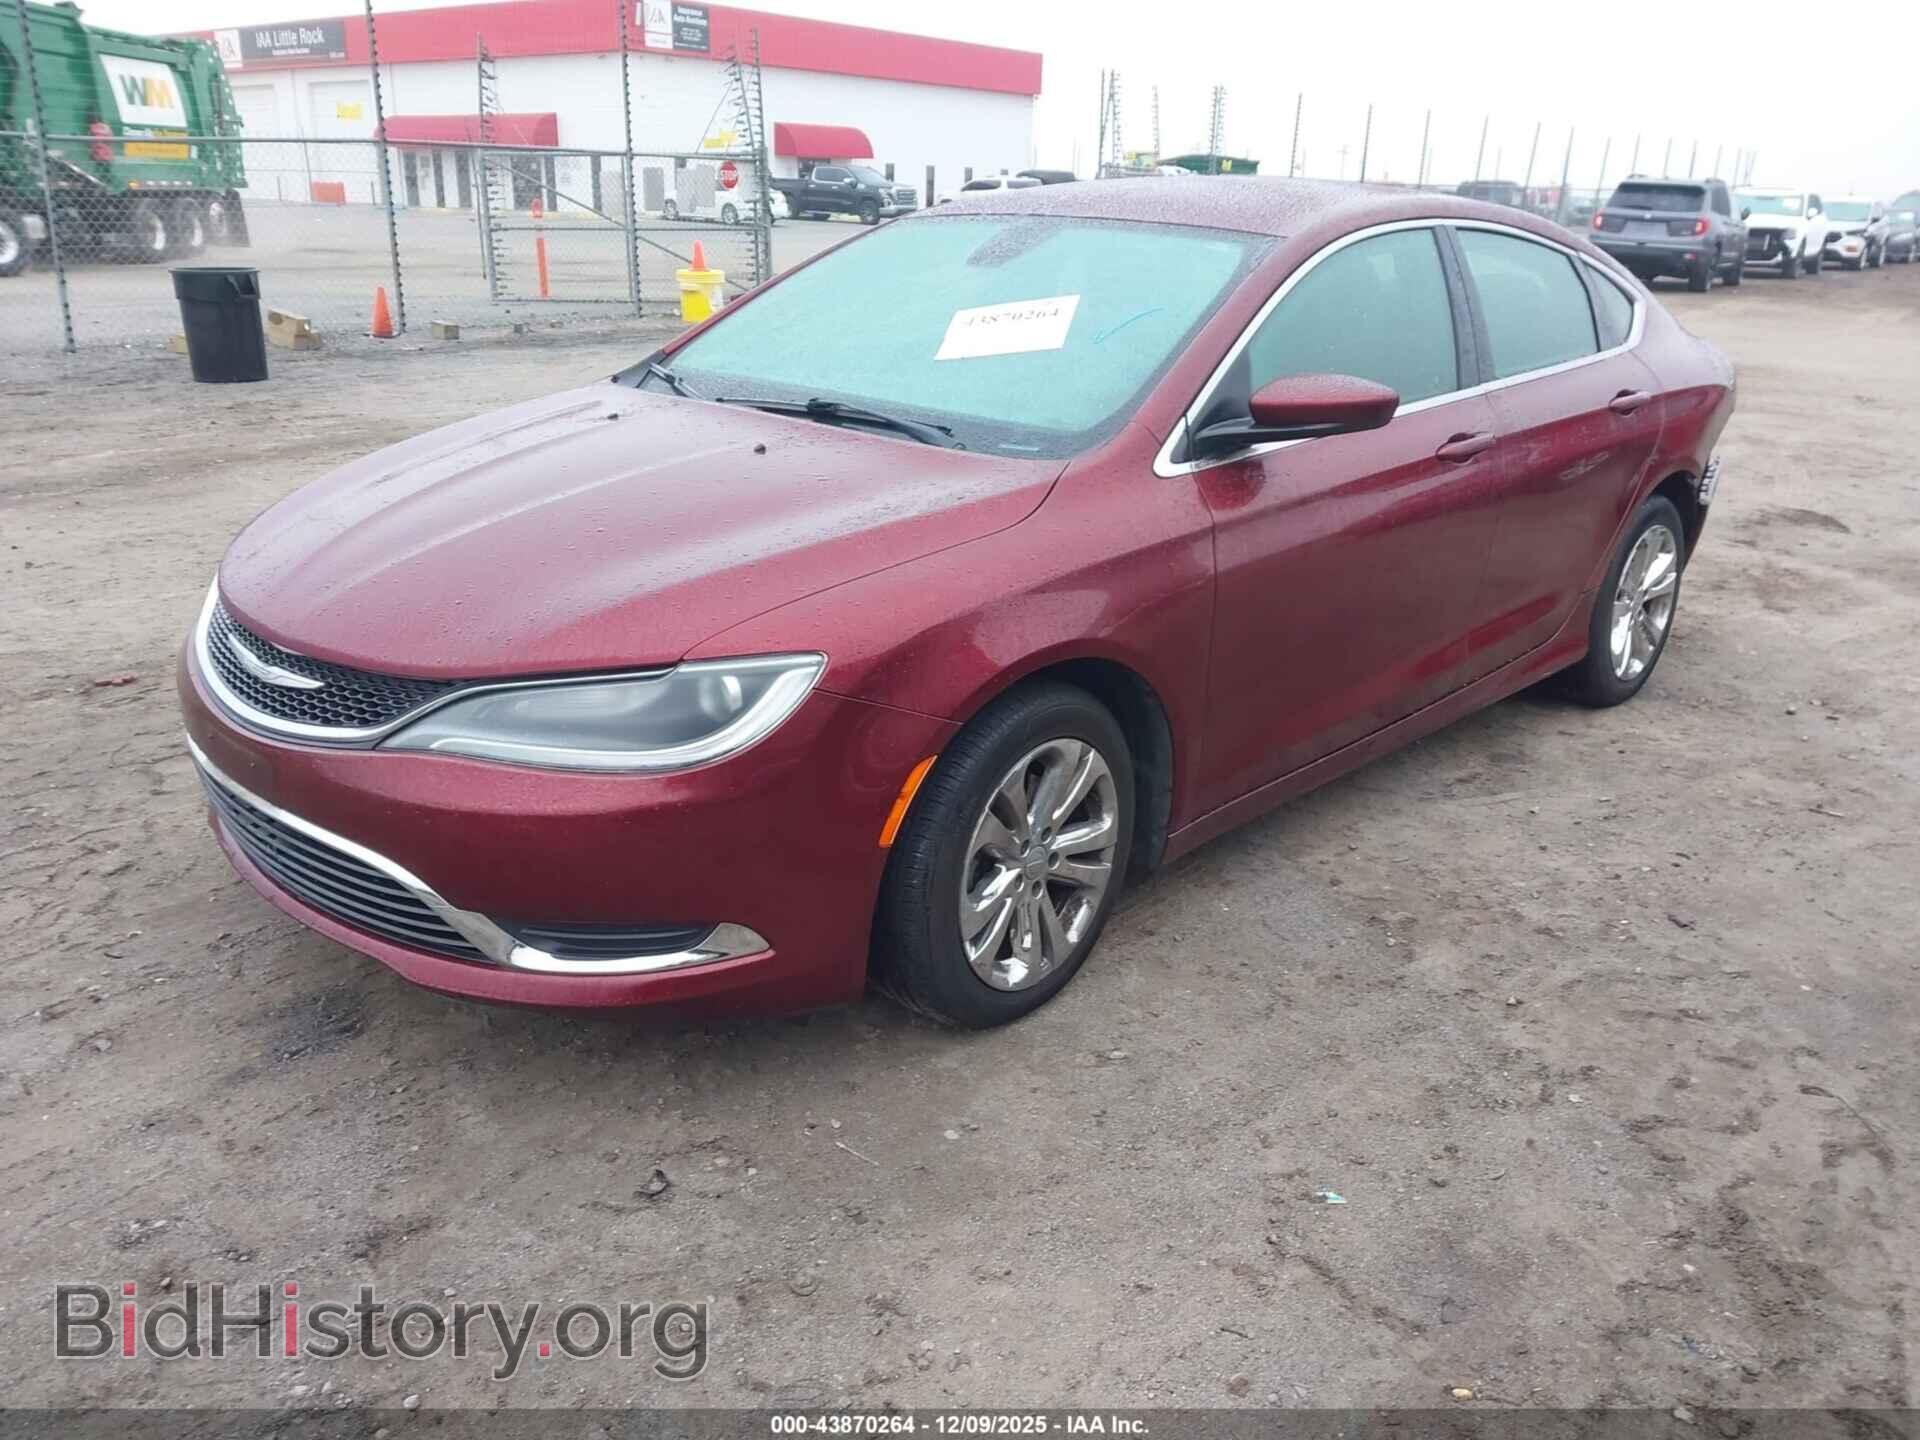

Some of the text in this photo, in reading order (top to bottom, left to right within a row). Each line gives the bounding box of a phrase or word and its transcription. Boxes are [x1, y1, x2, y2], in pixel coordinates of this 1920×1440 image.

[273, 29, 298, 47] Little
[299, 26, 325, 45] Rock
[118, 73, 175, 109] WM
